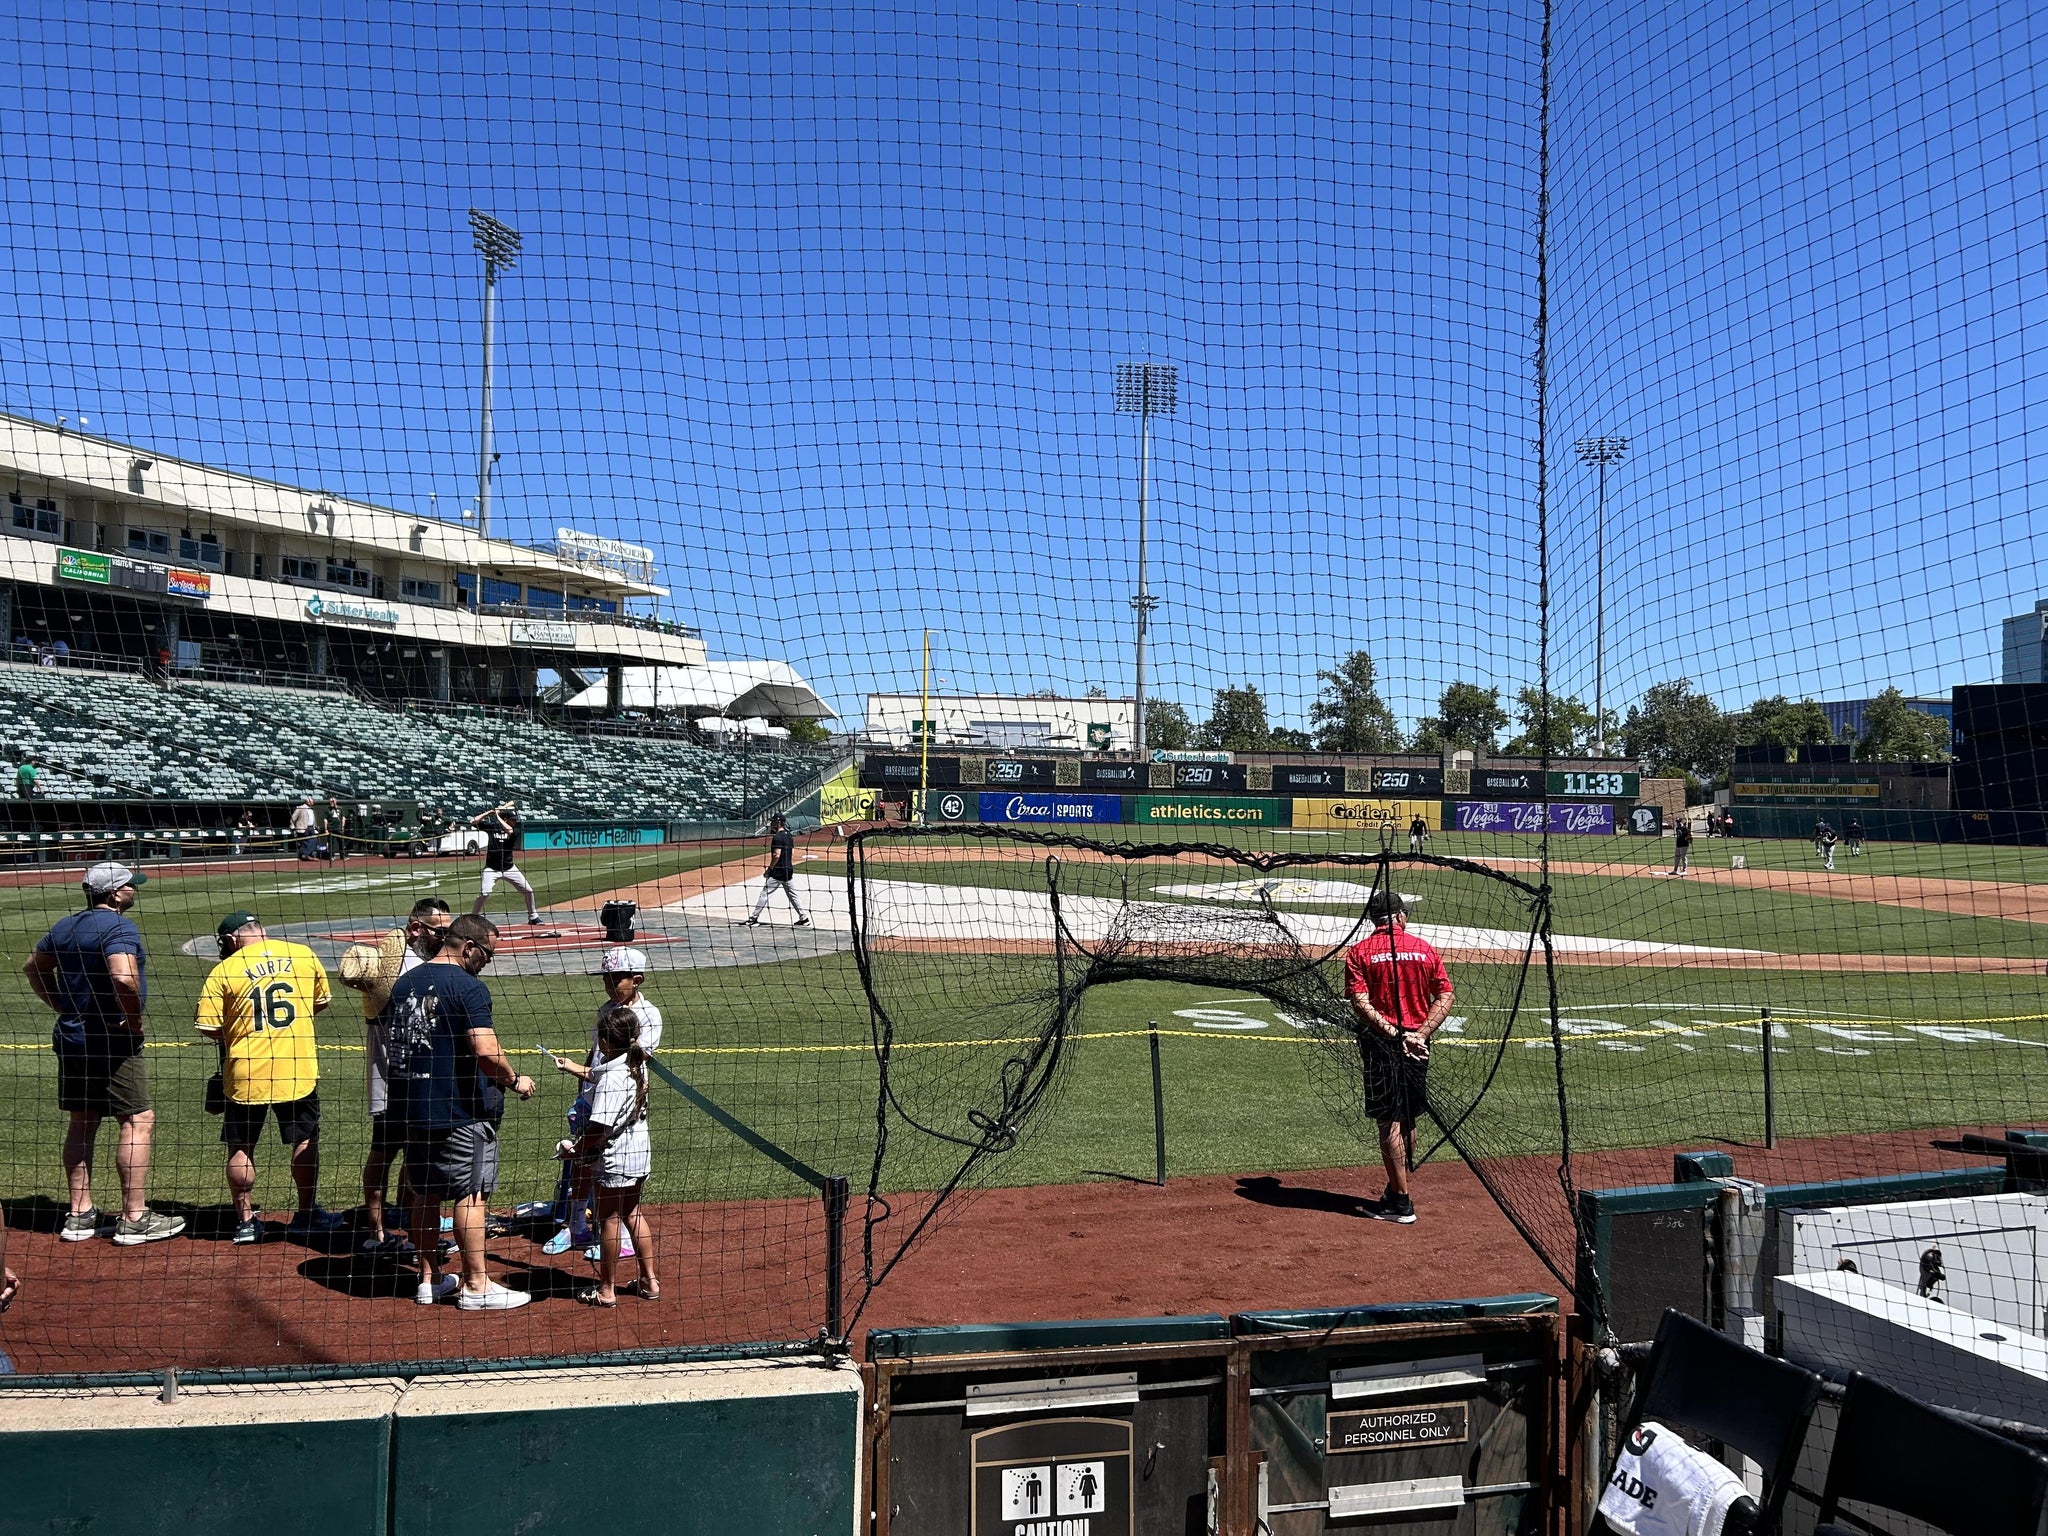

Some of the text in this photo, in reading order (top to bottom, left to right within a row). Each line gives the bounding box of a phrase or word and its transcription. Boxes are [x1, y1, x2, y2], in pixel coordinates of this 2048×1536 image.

[63, 567, 104, 579] CALIFORNIA
[987, 761, 1023, 780] $250
[1176, 766, 1213, 784] $250
[1373, 770, 1410, 788] $250
[1486, 777, 1519, 788] BASEBALLISM
[1563, 773, 1624, 795] 11:33
[1782, 786, 1808, 795] WORLD
[1809, 786, 1853, 796] CHAMPIONS
[944, 800, 960, 813] 42
[1005, 796, 1094, 821] Circa SPORTS
[1150, 804, 1264, 821] athletics.com
[1356, 820, 1378, 828] Credit
[1457, 804, 1506, 831] Vegas
[1560, 806, 1611, 832] Vegas
[564, 827, 643, 846] Sutter Health
[245, 958, 293, 981] KURTZ
[248, 982, 297, 1032] 16
[1359, 1412, 1437, 1429] AUTHORIZED
[1344, 1426, 1451, 1445] PERSONNEL ONLY
[1611, 1469, 1659, 1510] ADE
